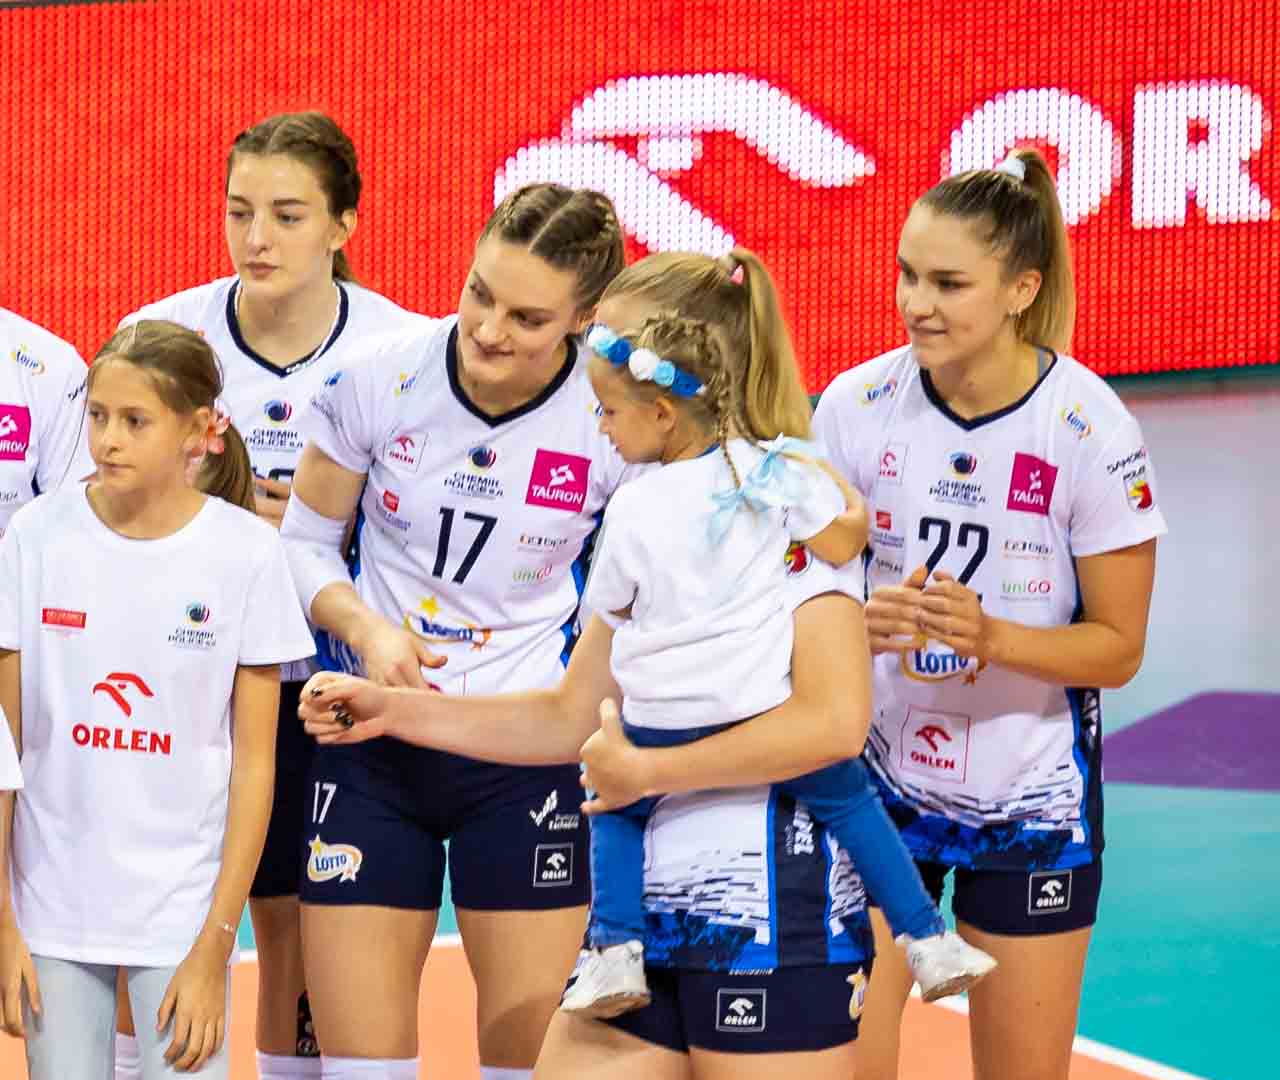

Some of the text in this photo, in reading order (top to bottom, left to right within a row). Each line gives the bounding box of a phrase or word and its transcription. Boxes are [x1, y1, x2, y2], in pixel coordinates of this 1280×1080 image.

[944, 79, 1272, 229] OR
[531, 484, 584, 505] TAURON
[432, 506, 499, 585] 17
[918, 516, 990, 598] 22
[914, 650, 969, 673] LOTTO
[72, 722, 171, 755] ORLEN
[910, 750, 955, 770] ORLEN
[312, 781, 337, 824] 17
[315, 853, 348, 872] LOTTO
[541, 869, 568, 881] ORLEN
[1036, 896, 1065, 908] ORLEN
[724, 1014, 757, 1025] ORLEN
